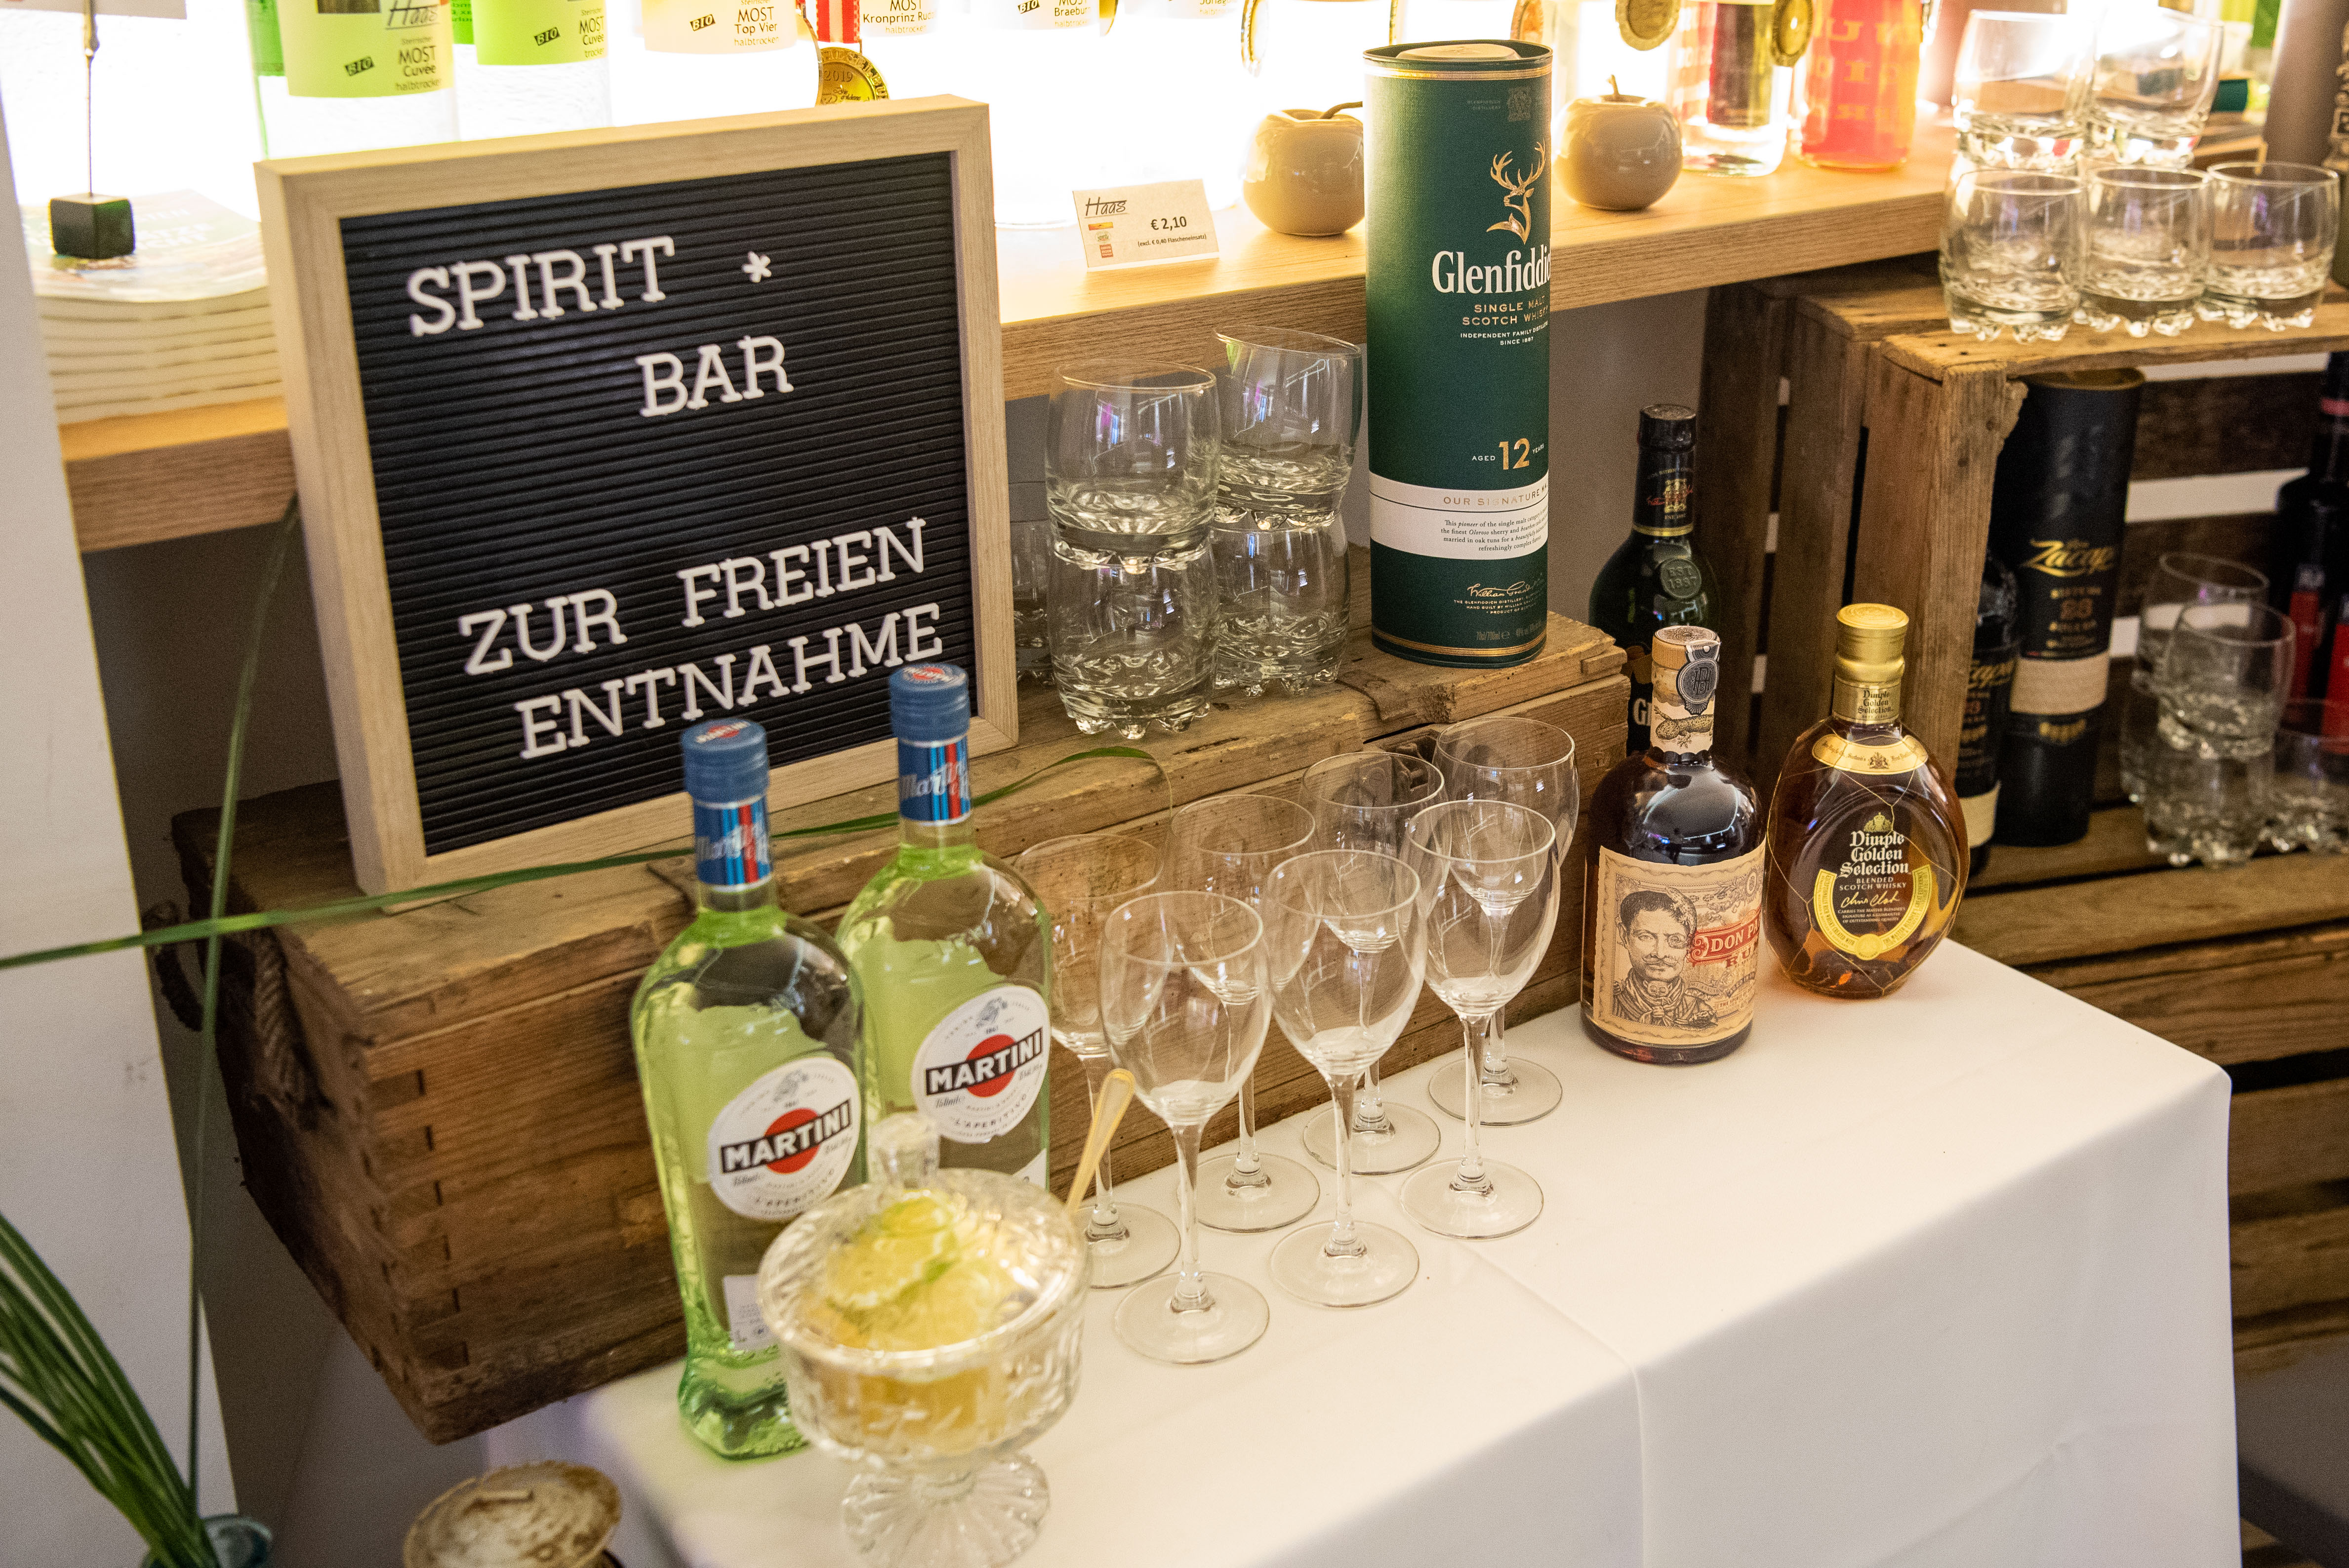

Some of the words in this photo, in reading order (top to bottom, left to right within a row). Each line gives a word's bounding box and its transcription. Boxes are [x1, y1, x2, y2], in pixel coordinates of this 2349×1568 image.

[890, 0, 921, 11] MOST
[1019, 0, 1039, 13] BIO
[691, 15, 715, 31] BIO
[738, 6, 774, 23] MOST
[863, 13, 914, 25] Kronprinz
[579, 16, 604, 35] MOST
[734, 24, 755, 36] Top
[759, 22, 777, 33] Vier
[535, 28, 560, 45] BIO
[398, 45, 436, 65] MOST
[823, 71, 853, 82] 2019
[1085, 197, 1127, 216] Haas
[1151, 219, 1159, 231] €
[1162, 216, 1187, 231] 2,10
[1168, 233, 1207, 244] Flascheneinsatz)
[407, 236, 675, 337] SPIRIT
[1474, 302, 1523, 313] SINGLE
[1529, 295, 1545, 309] MALT
[1462, 315, 1517, 326] SCOTCH
[1512, 328, 1532, 337] FAMILY
[635, 335, 794, 417] BAR
[1498, 438, 1530, 470] 12
[1532, 443, 1544, 454] YEARS
[1443, 496, 1471, 506] OUR
[1477, 488, 1540, 506] SIGNATURE
[1513, 540, 1532, 549] complex
[458, 589, 628, 676] ZUR
[677, 517, 927, 627] FREIEN
[514, 602, 943, 760] ENTNAHME
[1863, 698, 1889, 707] Golden
[1850, 830, 1905, 849] Dimple
[1851, 846, 1903, 862] Golden
[1840, 861, 1909, 878] Selection
[1710, 929, 1744, 953] DON
[927, 1029, 1042, 1094] MARTINI
[724, 1101, 850, 1172] MARTINI
